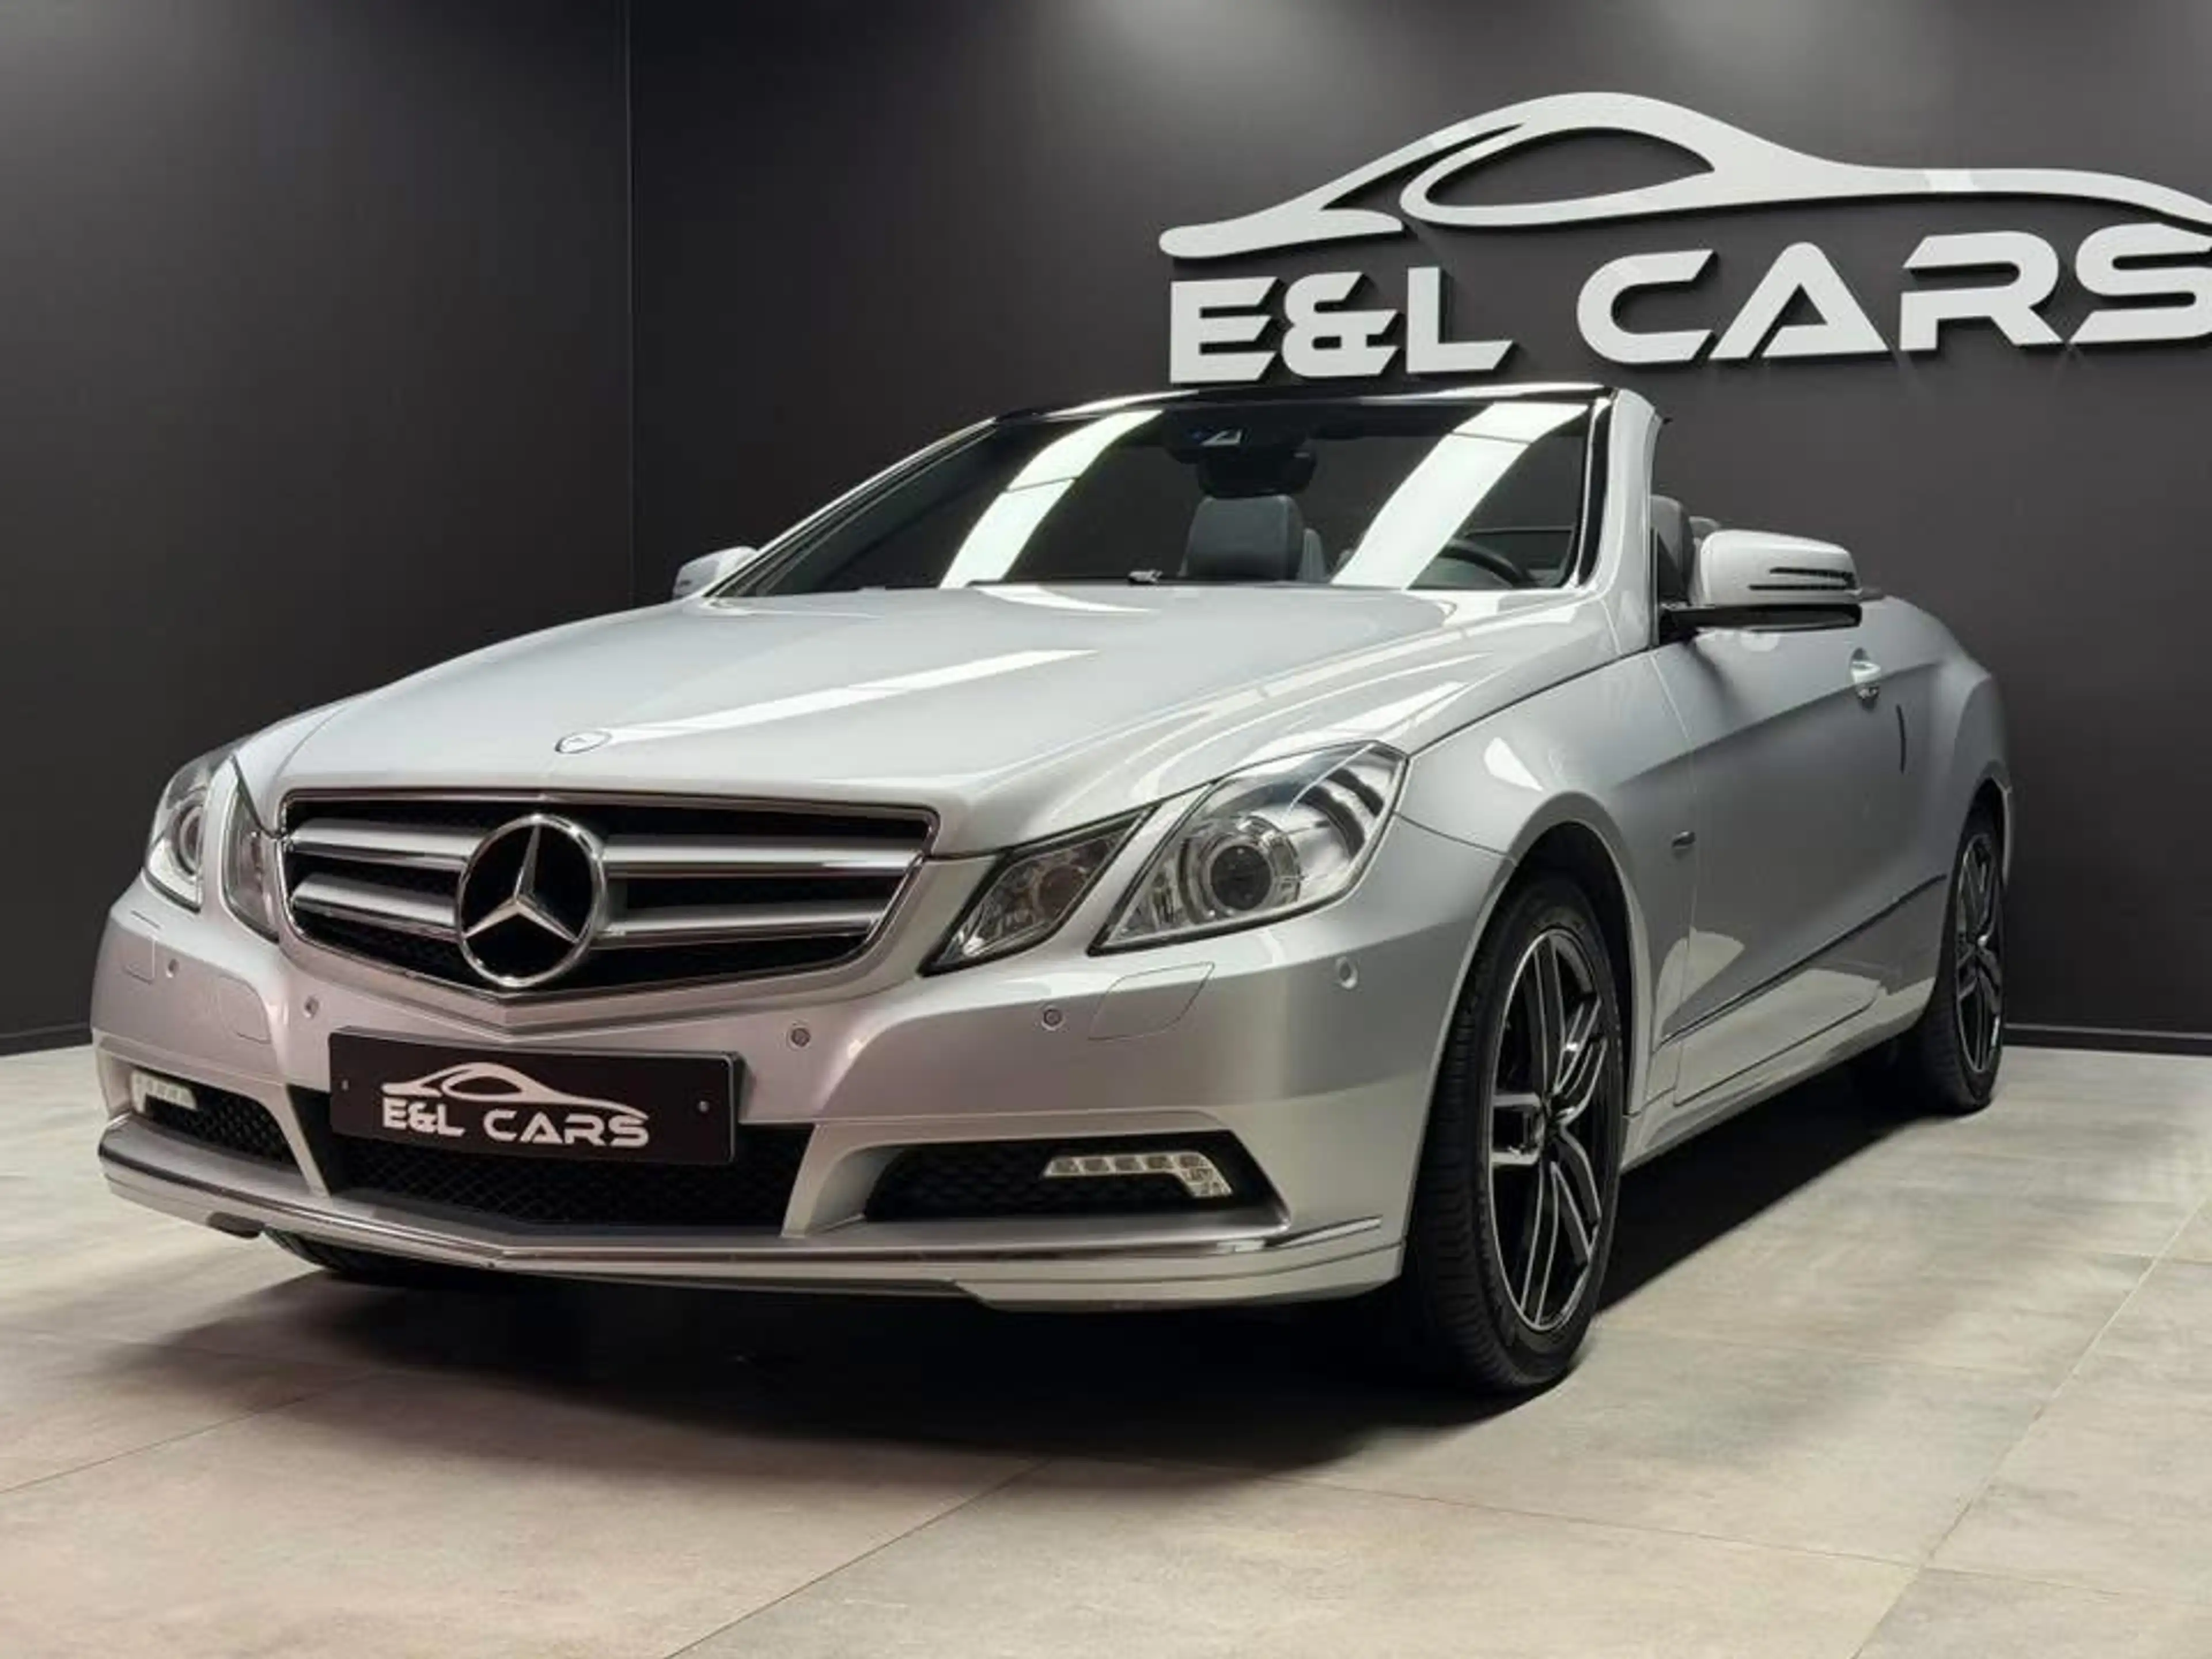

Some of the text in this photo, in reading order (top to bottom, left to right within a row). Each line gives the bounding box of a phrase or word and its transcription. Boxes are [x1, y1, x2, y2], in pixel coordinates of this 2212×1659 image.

[1170, 224, 2212, 383] E&L CARS
[382, 1097, 649, 1147] E&L CARS
